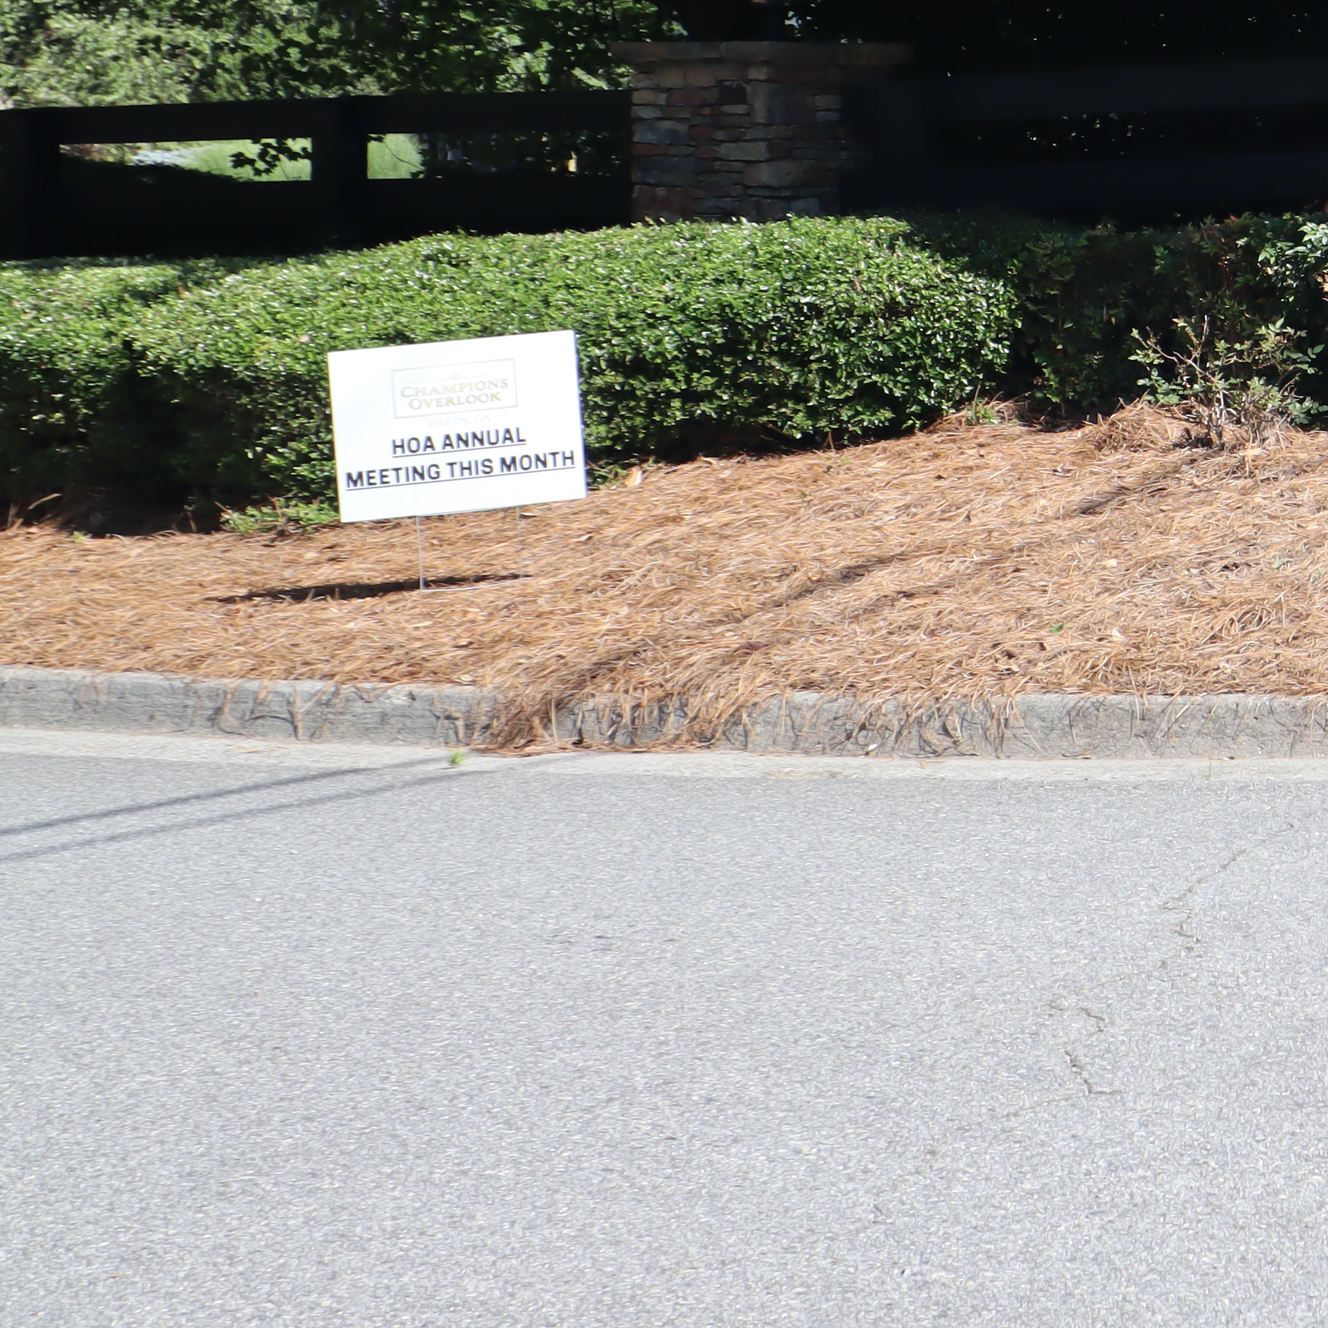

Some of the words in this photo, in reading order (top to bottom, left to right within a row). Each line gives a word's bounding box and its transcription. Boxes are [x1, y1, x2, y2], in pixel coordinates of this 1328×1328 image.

[400, 378, 509, 398] CHAMPIONS
[409, 392, 502, 410] OVERLOOK
[392, 433, 436, 455] HOA
[442, 427, 527, 450] ANNUAL
[346, 463, 440, 489] MEETING
[447, 458, 494, 477] THIS
[500, 450, 575, 473] MONTH
